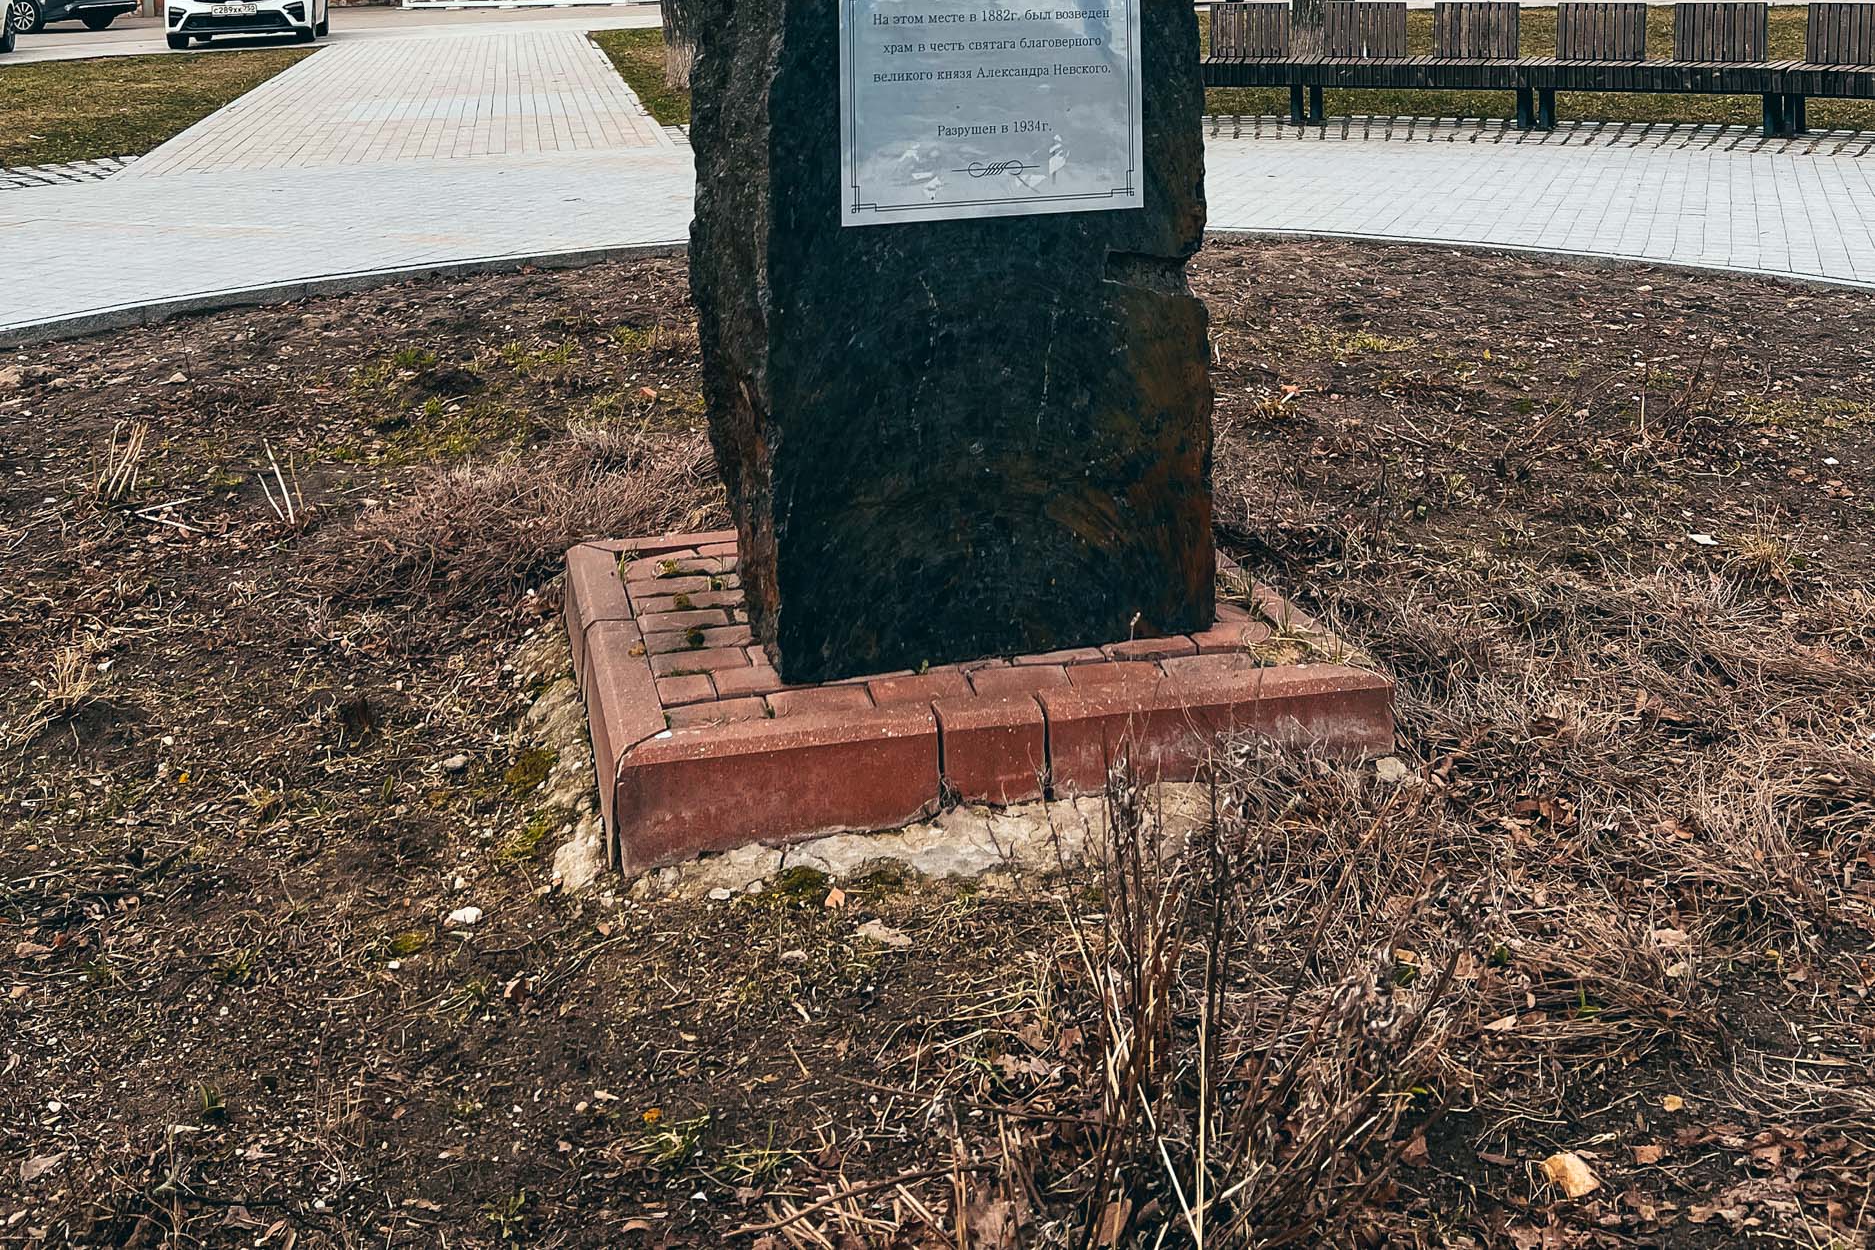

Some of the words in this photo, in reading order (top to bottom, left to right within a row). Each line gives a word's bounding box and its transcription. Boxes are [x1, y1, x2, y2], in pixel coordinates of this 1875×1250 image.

[873, 13, 888, 25] На
[893, 14, 923, 24] этом
[928, 13, 964, 23] месте
[969, 13, 977, 22] в
[982, 9, 1021, 22] 1882г.
[1024, 8, 1051, 20] был
[1055, 8, 1110, 21] возведен
[883, 43, 913, 54] храм
[918, 43, 926, 52] в
[930, 41, 965, 52] честь
[968, 40, 1016, 50] святага
[1019, 37, 1102, 49] благоверного
[873, 71, 933, 83] великого
[937, 69, 972, 80] князя
[976, 66, 1049, 78] Александра
[1053, 62, 1112, 76] Невского.
[937, 125, 997, 138] Разрушен
[1001, 124, 1009, 133] в
[1013, 120, 1052, 133] 1934г.
